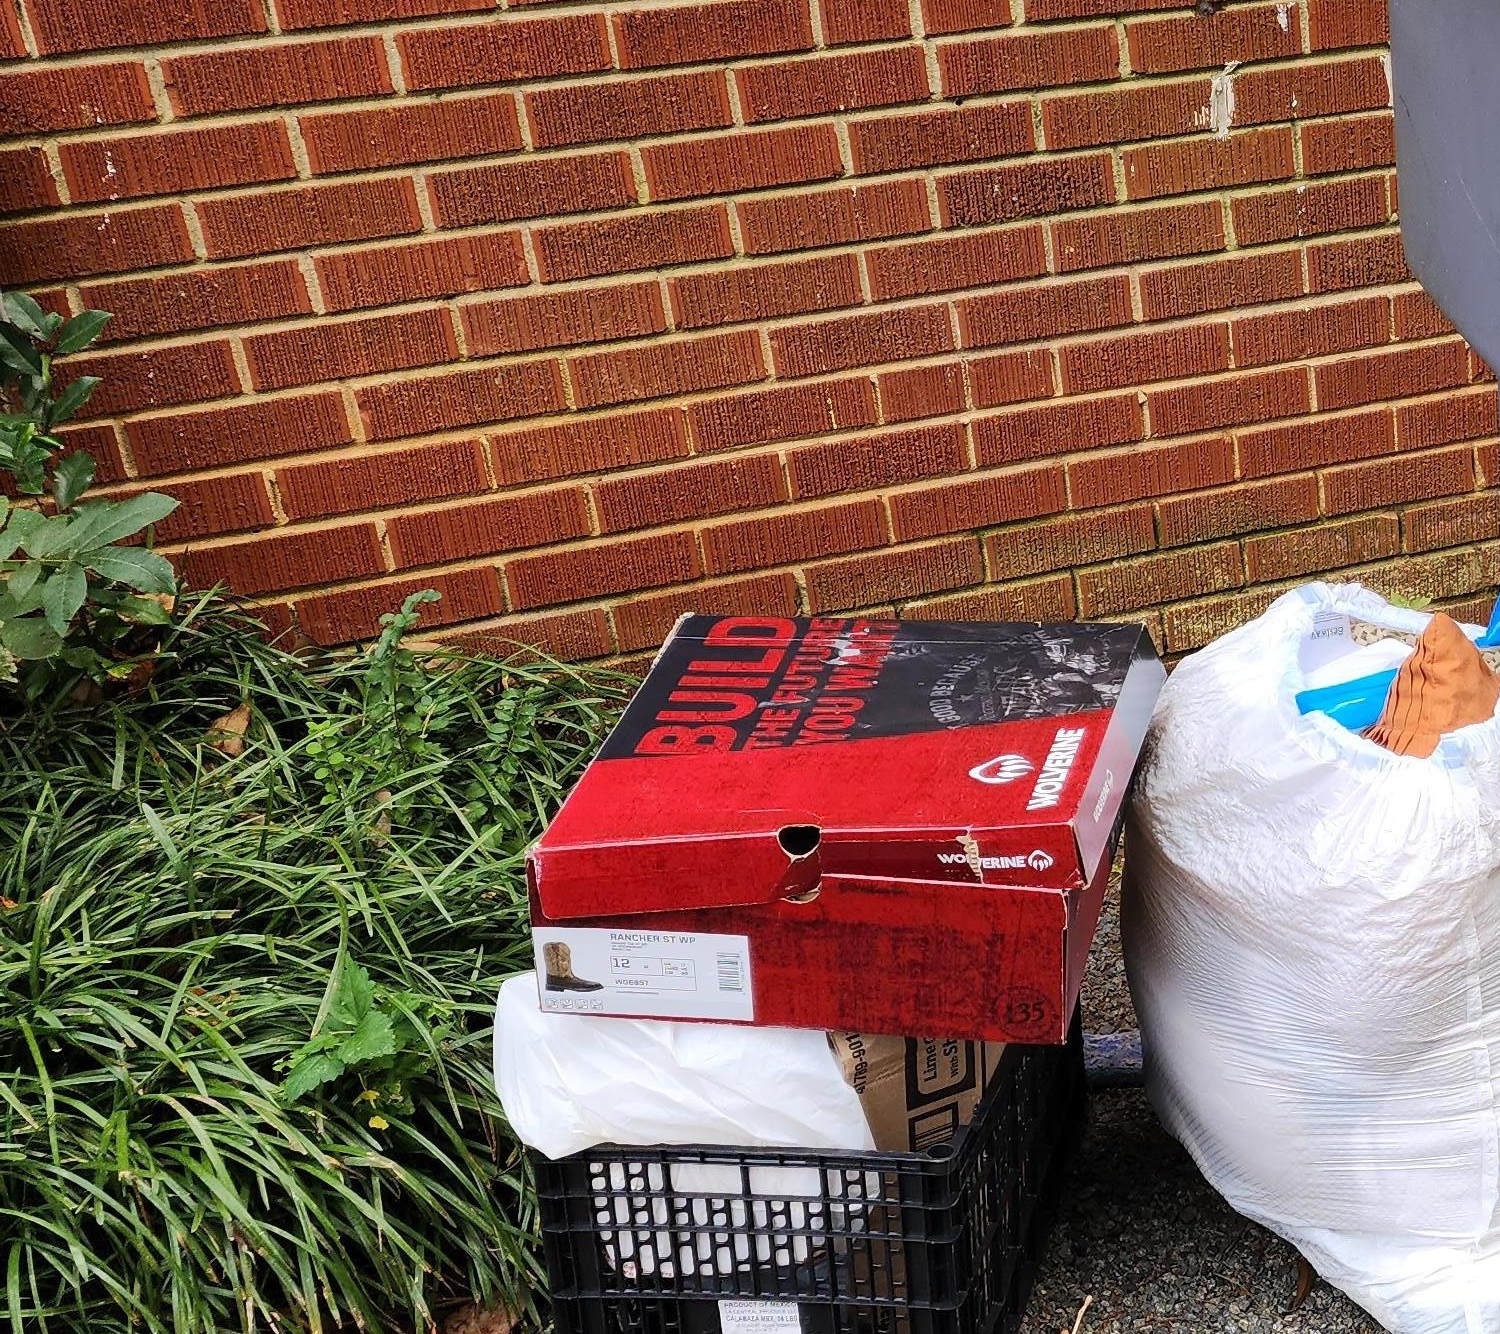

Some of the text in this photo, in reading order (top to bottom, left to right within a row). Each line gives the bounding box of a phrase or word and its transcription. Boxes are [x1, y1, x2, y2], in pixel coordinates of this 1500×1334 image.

[634, 617, 797, 754] BUILD
[743, 617, 846, 751] THE FUTURE
[792, 620, 900, 746] YOU WANT
[1026, 727, 1085, 810] WOLVERINE
[610, 933, 696, 944] RANCHER ST WP
[613, 957, 631, 968] 12
[845, 1031, 868, 1095] 41789-901
[923, 1043, 938, 1083] Lime
